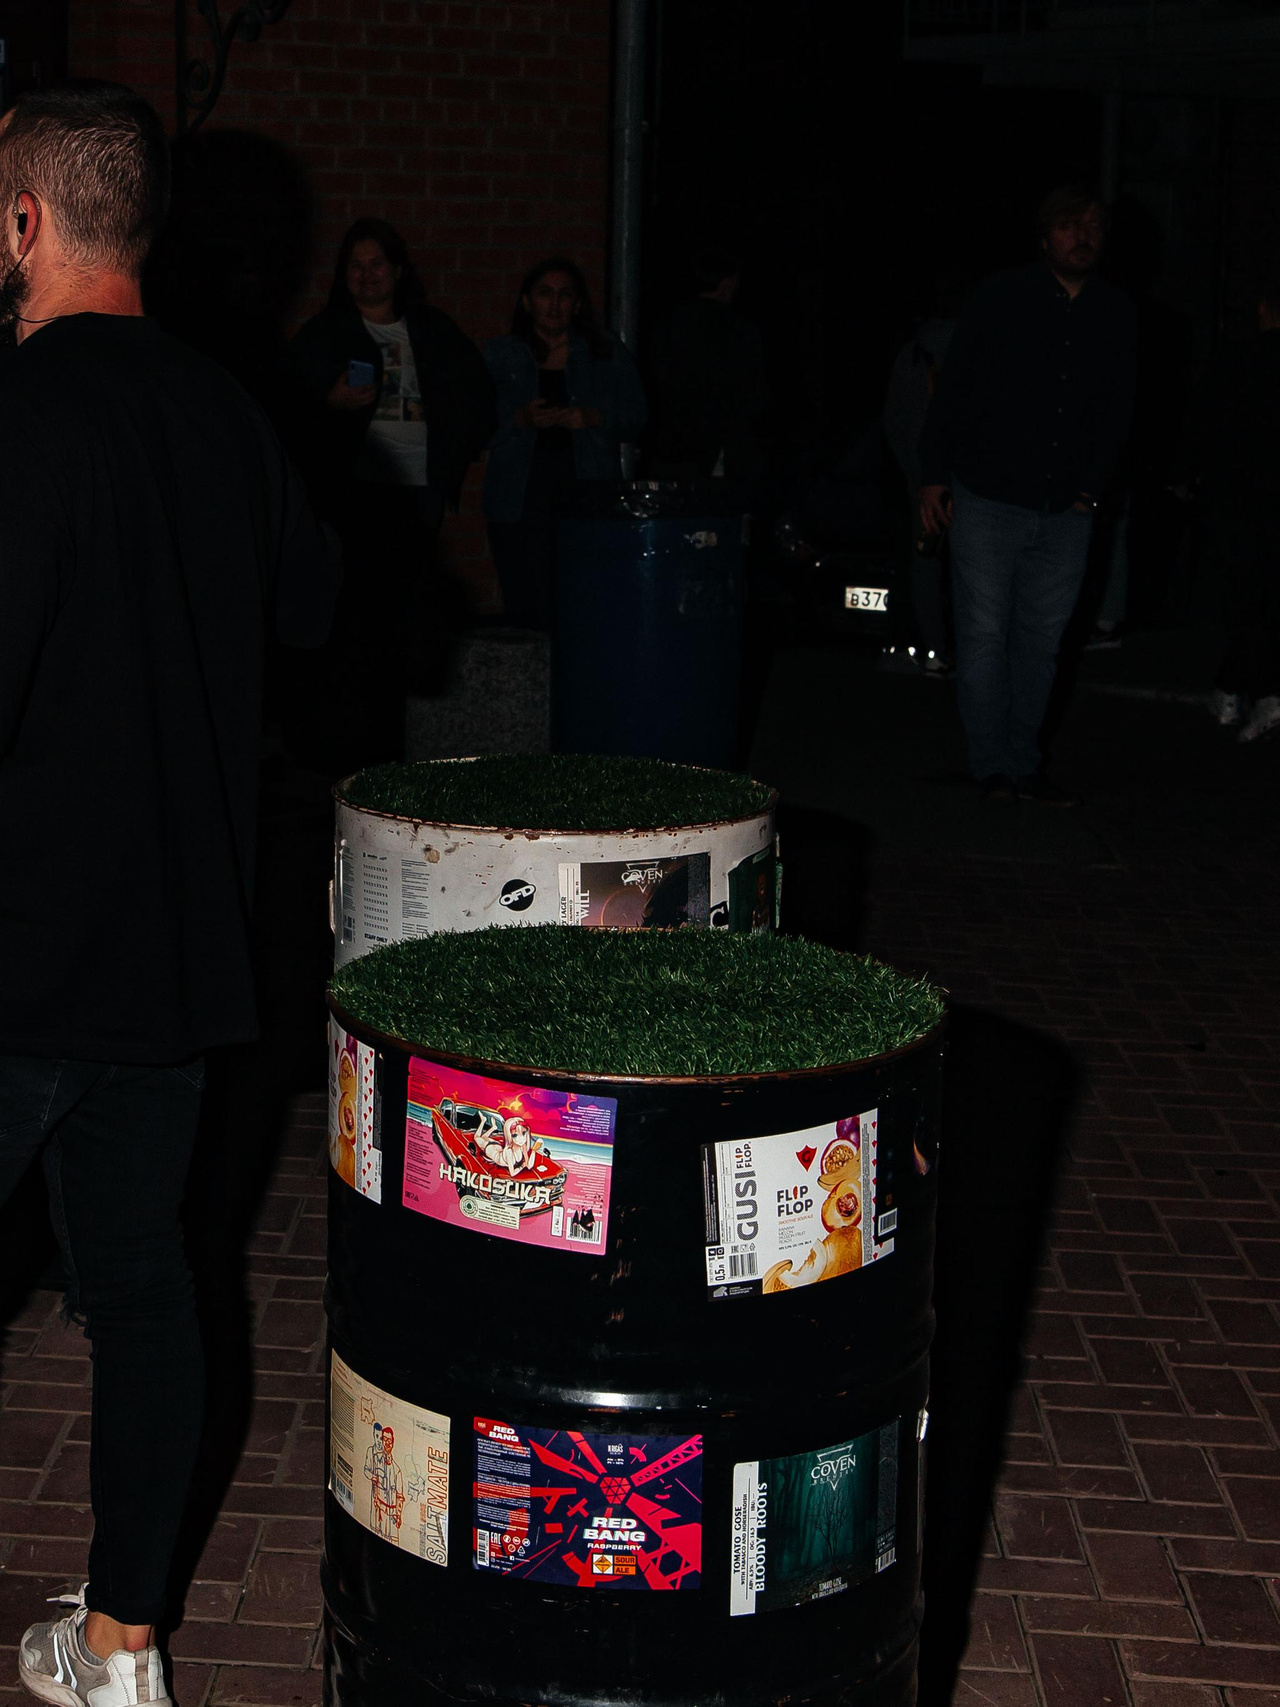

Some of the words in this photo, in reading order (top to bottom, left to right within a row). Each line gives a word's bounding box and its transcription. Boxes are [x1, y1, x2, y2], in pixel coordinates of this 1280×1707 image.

[621, 869, 663, 881] COVEN
[500, 885, 535, 905] OFD
[581, 890, 590, 919] WILL
[735, 1147, 744, 1169] FLIP
[439, 1163, 551, 1204] HAKOSUKA
[777, 1185, 809, 1202] FLIP
[735, 1170, 759, 1241] GUSI
[777, 1199, 814, 1217] FLOP
[489, 1431, 519, 1442] BANG
[493, 1425, 516, 1435] RED
[811, 1455, 856, 1479] COVEN
[757, 1482, 768, 1529] ROOTS
[592, 1517, 637, 1529] RED
[734, 1506, 742, 1531] GOSE
[583, 1529, 645, 1542] BANG
[587, 1543, 642, 1551] RASPBERRY
[615, 1556, 635, 1564] SOUR
[755, 1536, 767, 1592] BLOODY
